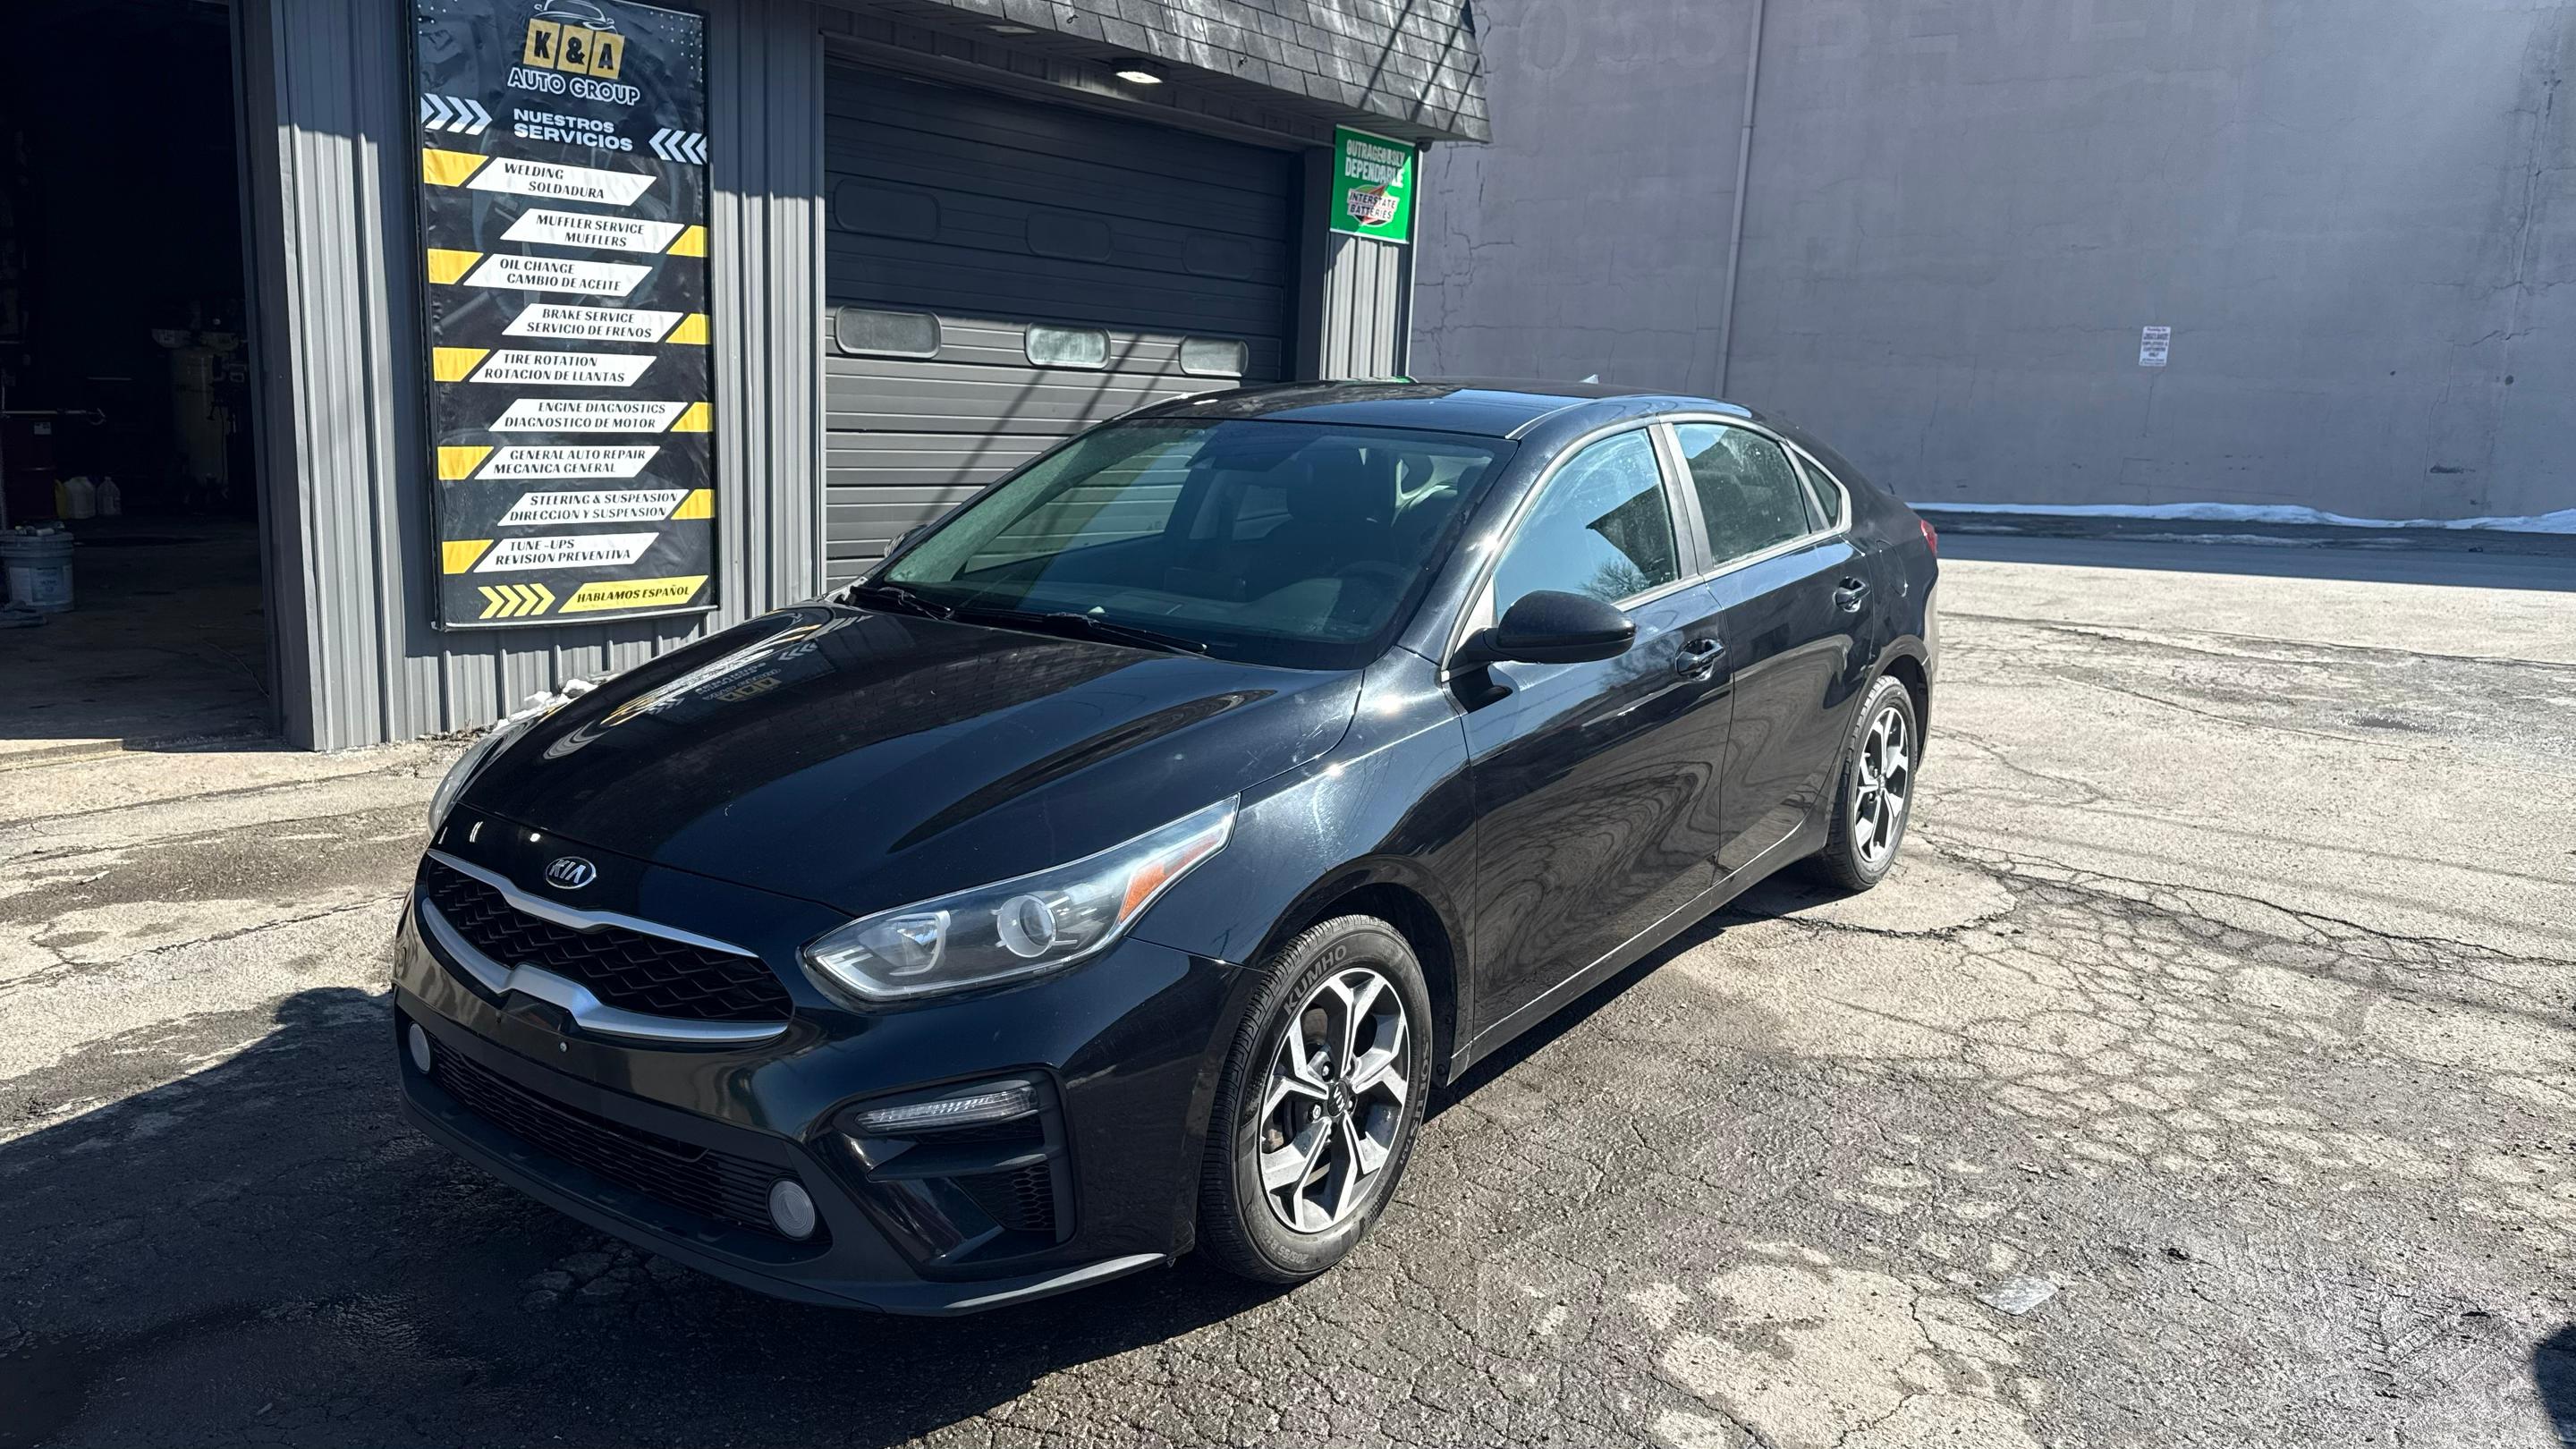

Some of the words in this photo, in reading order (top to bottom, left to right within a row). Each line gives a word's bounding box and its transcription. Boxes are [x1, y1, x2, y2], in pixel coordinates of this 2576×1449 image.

[508, 67, 566, 95] AUTO
[570, 79, 640, 106] GROUP
[513, 108, 615, 133] NUESTROS
[513, 123, 634, 152] SERVICIOS
[1346, 140, 1405, 167] OUTRAGEOUSLY
[504, 163, 564, 180] WELDING
[1344, 157, 1405, 189] DEPENDABLE
[528, 181, 605, 199] SOLDADURA
[1349, 191, 1396, 209] INTERSTATE
[1350, 204, 1392, 220] BATTERIES
[537, 214, 592, 232] MUFFLER
[595, 219, 645, 235] SERVICE
[564, 233, 627, 248] MUFFLERS
[499, 258, 522, 271] OIL
[524, 260, 575, 275] CHANGE
[506, 273, 559, 287] CAMBIO
[561, 277, 578, 289] DE
[579, 279, 622, 292] ACEITE
[542, 308, 582, 321] BRAKE
[584, 310, 635, 324] SERVICE
[526, 321, 586, 335] SERVICIO
[587, 326, 604, 336] DE
[605, 326, 652, 339] FRENOS
[504, 353, 532, 365] TIRE
[533, 354, 597, 368] ROTATION
[484, 368, 552, 381] ROTACION
[553, 369, 570, 381] DE
[572, 370, 625, 383] LLANTAS
[538, 402, 583, 414] ENGINE
[585, 402, 666, 415] DIAGNOSTICS
[504, 417, 592, 428] DIAGNOSTICO
[594, 417, 610, 428] DE
[612, 417, 656, 428] MOTOR
[510, 449, 565, 461] GENERAL
[567, 449, 601, 461] AUTO
[603, 449, 646, 461] REPAIR
[493, 462, 562, 475] MECANICA
[564, 462, 616, 474] GENERAL
[530, 494, 590, 507] STEERING
[592, 494, 601, 504] &
[603, 493, 678, 504] SUSPENSION
[509, 509, 581, 522] DIRECCION
[582, 509, 591, 519] Y
[592, 506, 667, 520] SUSPENSION
[495, 552, 556, 565] REVISION
[557, 549, 631, 563] PREVENTIVA
[576, 588, 640, 604] HABLAMOS
[641, 584, 690, 598] ESPAÑOL
[548, 859, 587, 884] KIA
[1284, 945, 1347, 1015] KUMHO
